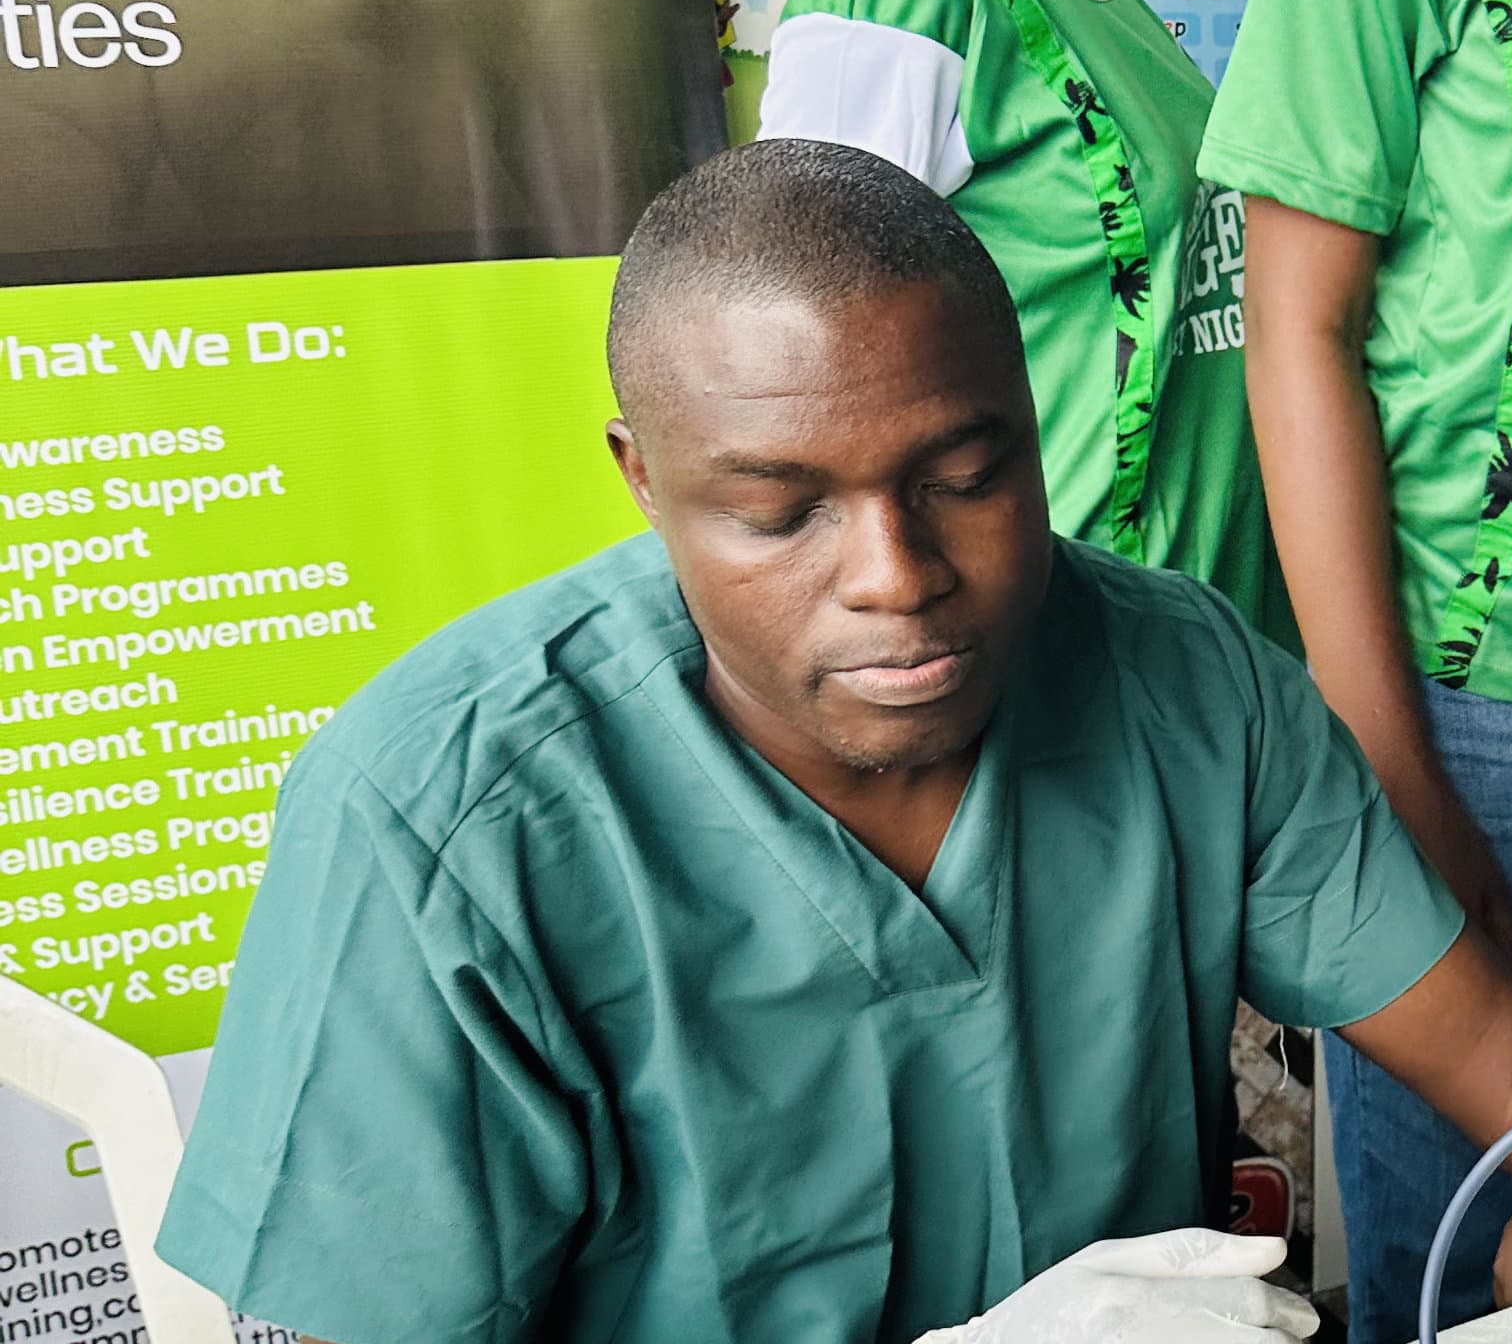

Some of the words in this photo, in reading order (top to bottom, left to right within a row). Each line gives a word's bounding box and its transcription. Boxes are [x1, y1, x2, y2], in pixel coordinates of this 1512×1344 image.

[0, 333, 118, 380] hat
[131, 327, 229, 370] We
[247, 322, 346, 363] Do:
[103, 465, 285, 516] Support
[52, 560, 349, 617] Programmes
[43, 601, 376, 670] Empowerment
[32, 912, 215, 970] Support
[125, 971, 156, 1003] &
